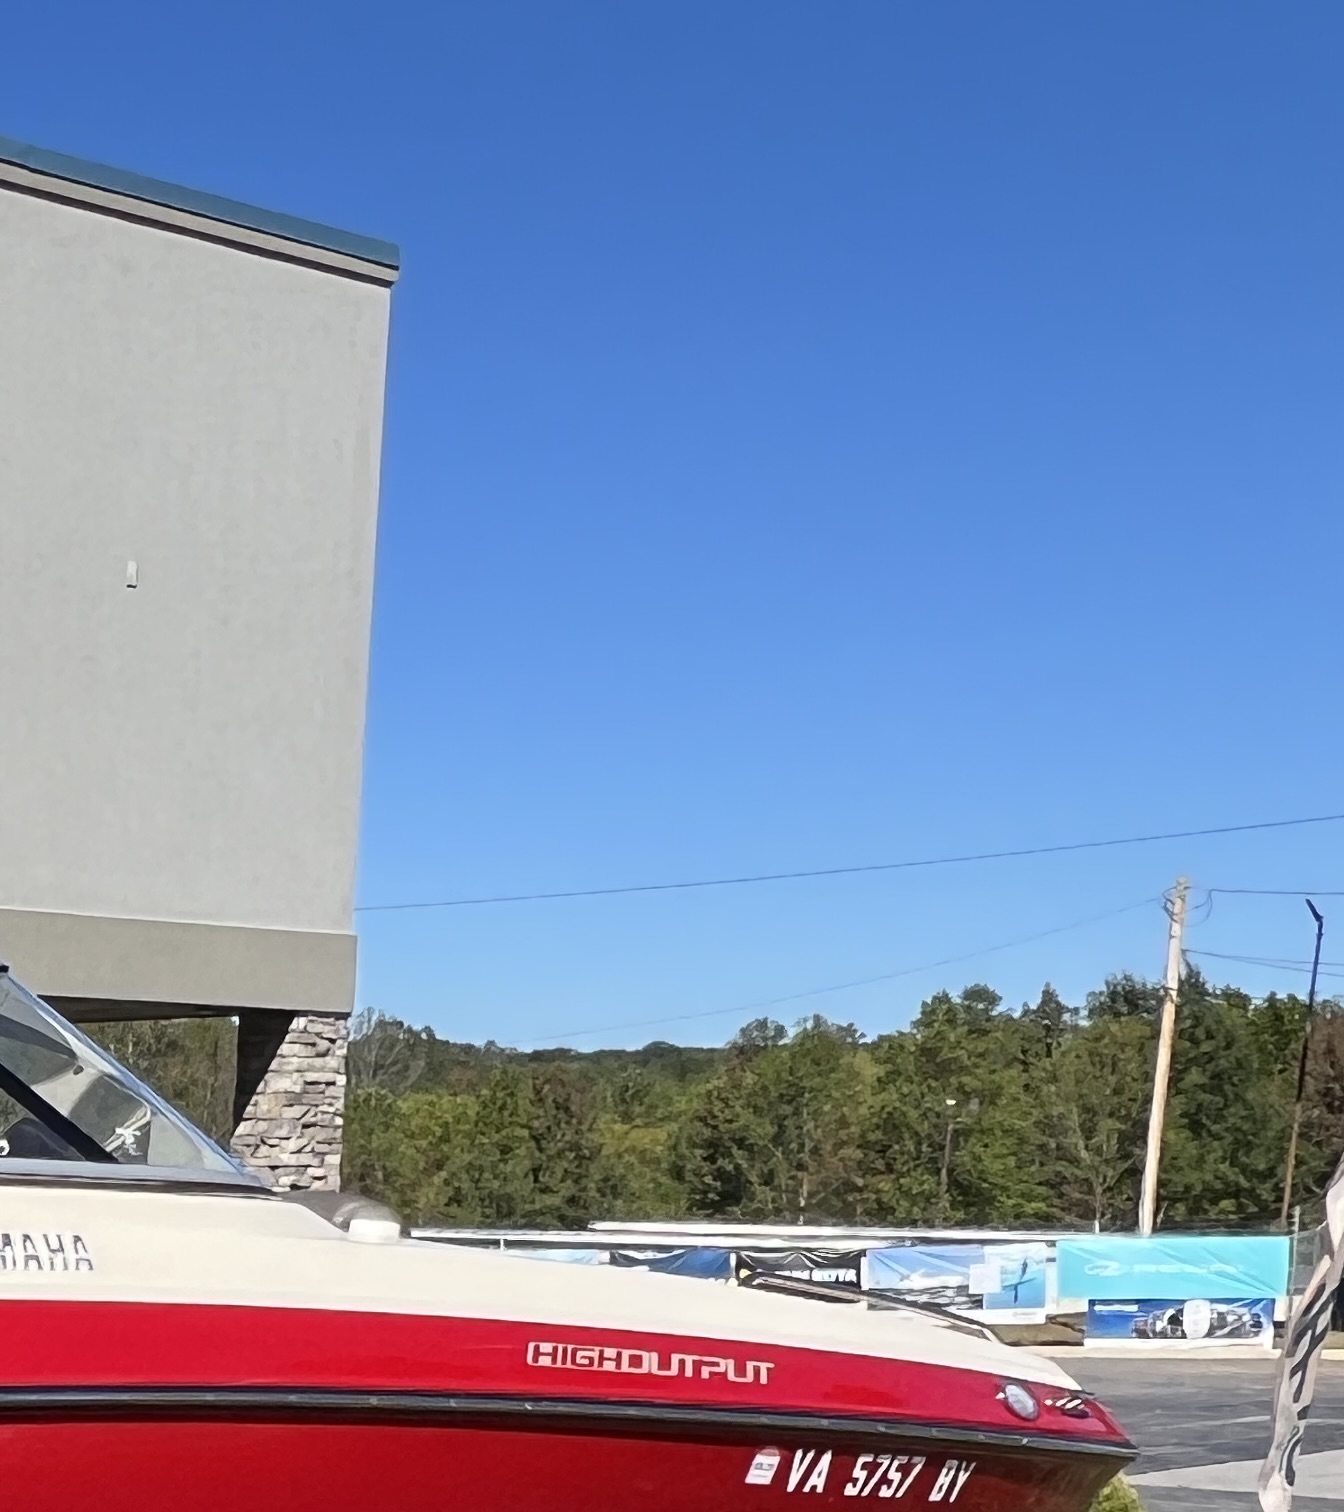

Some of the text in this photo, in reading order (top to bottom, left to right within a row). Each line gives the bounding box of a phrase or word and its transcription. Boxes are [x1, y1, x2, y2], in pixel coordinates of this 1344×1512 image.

[786, 1449, 977, 1503] VA 5757 BY
